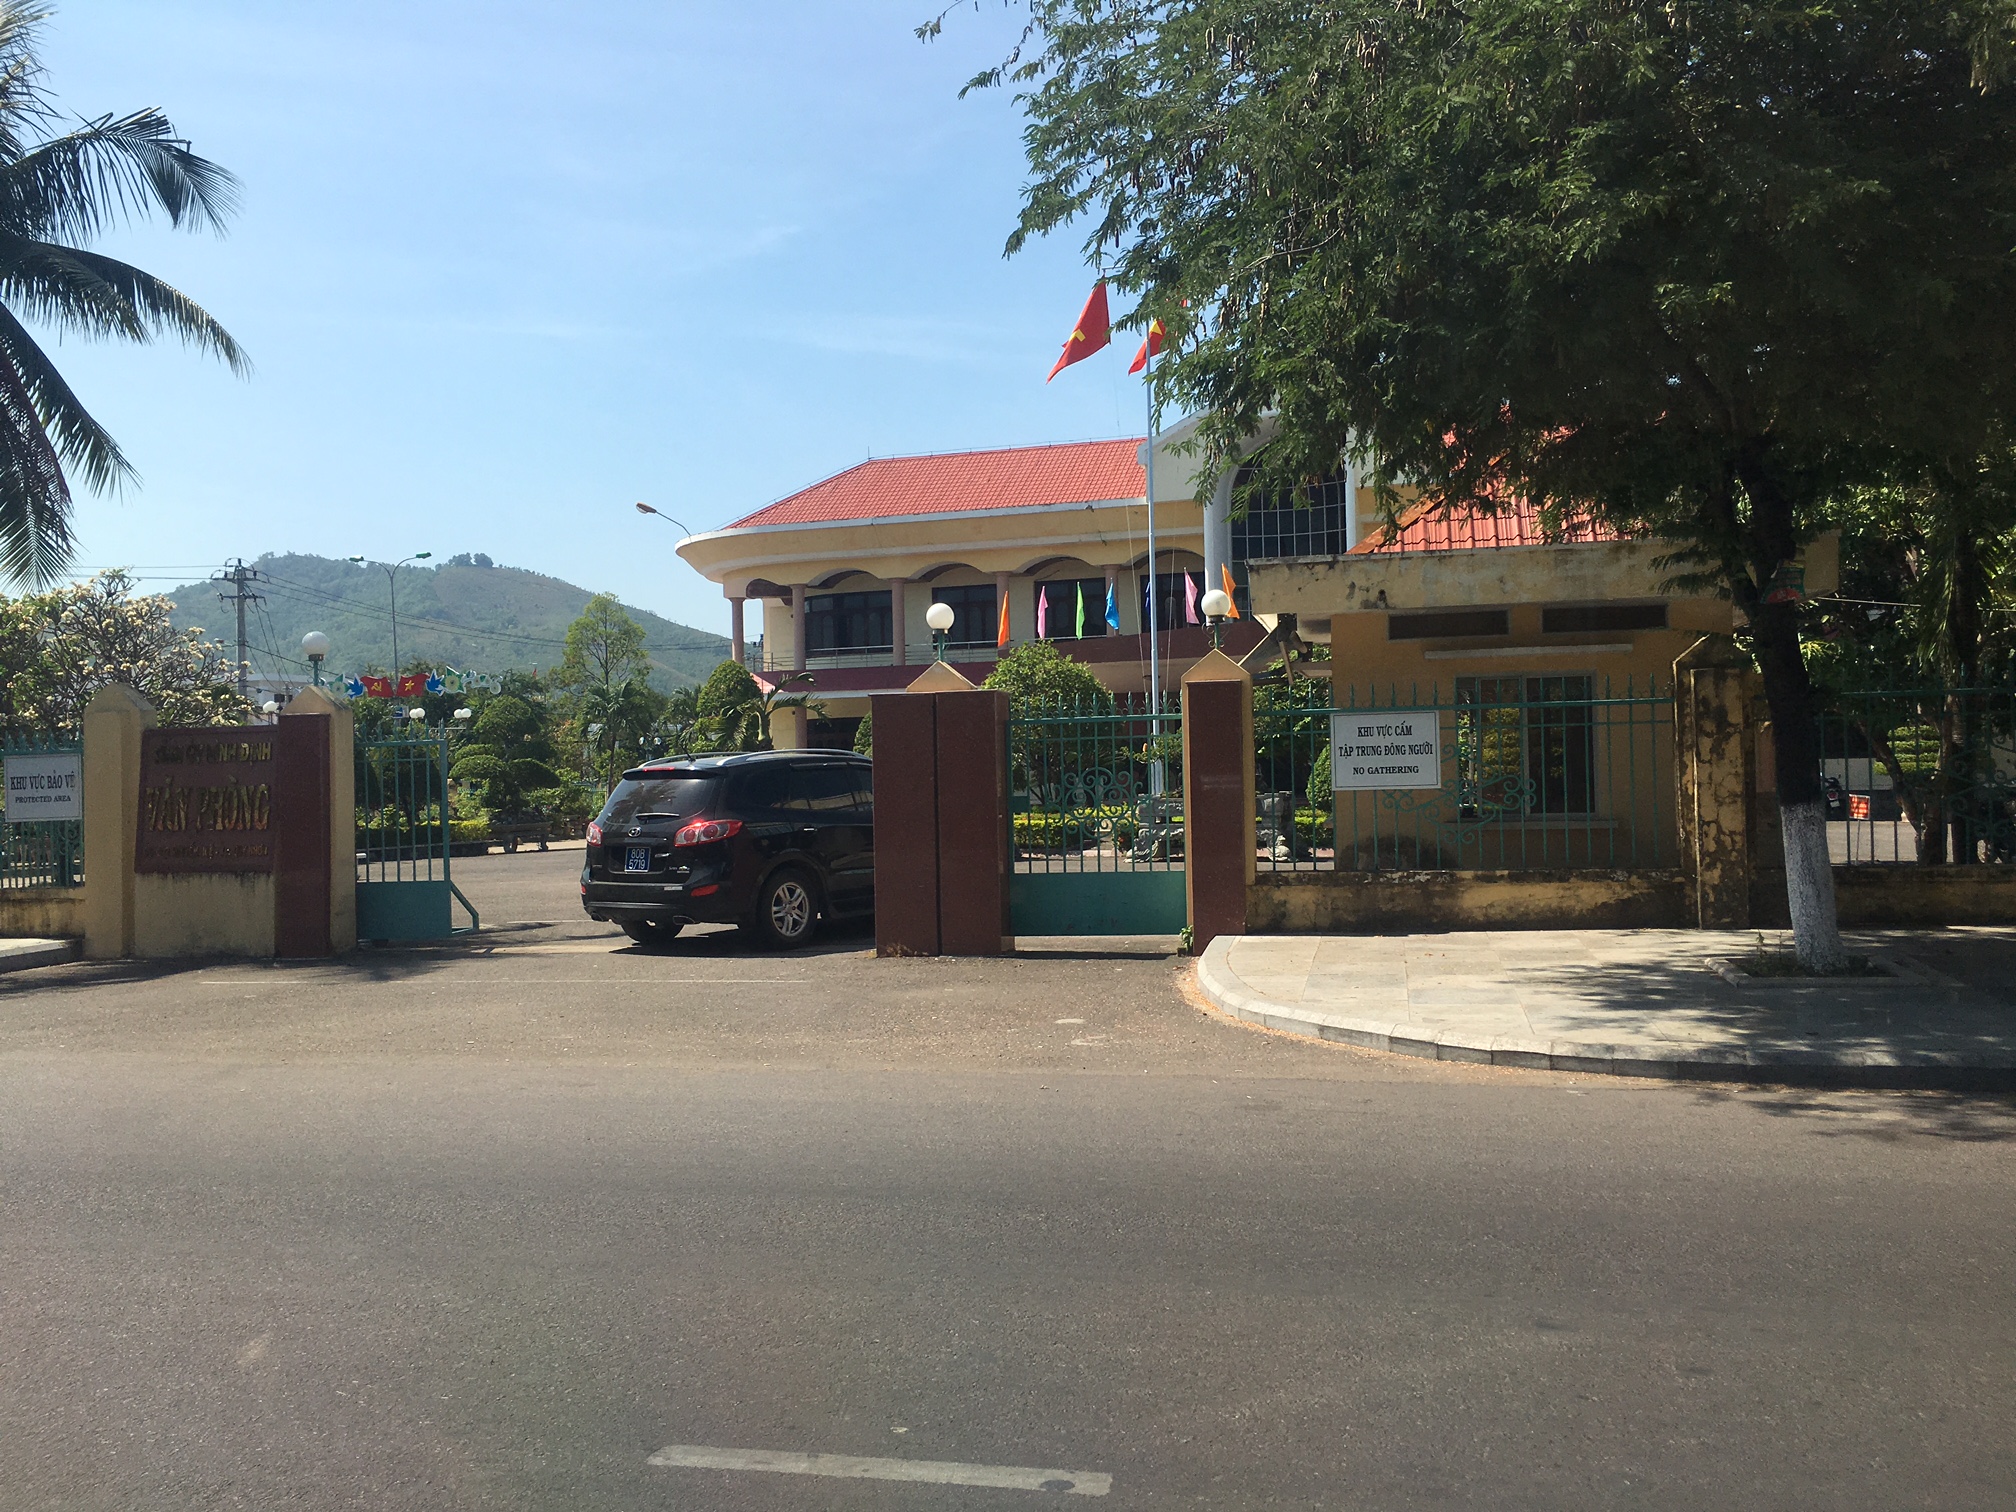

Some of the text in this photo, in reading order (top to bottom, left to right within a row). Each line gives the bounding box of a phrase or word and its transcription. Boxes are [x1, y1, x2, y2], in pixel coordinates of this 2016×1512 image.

[1357, 720, 1413, 739] KHU VỰC CẤM
[1338, 741, 1433, 759] TẬP TRUNG ĐÔNG NGƯỜI
[1353, 765, 1419, 775] NO GATHERING
[10, 769, 76, 792] KHU VỰC BẢO VỆ
[54, 795, 72, 803] AREA
[630, 848, 645, 859] 80B
[628, 859, 646, 870] 5719
